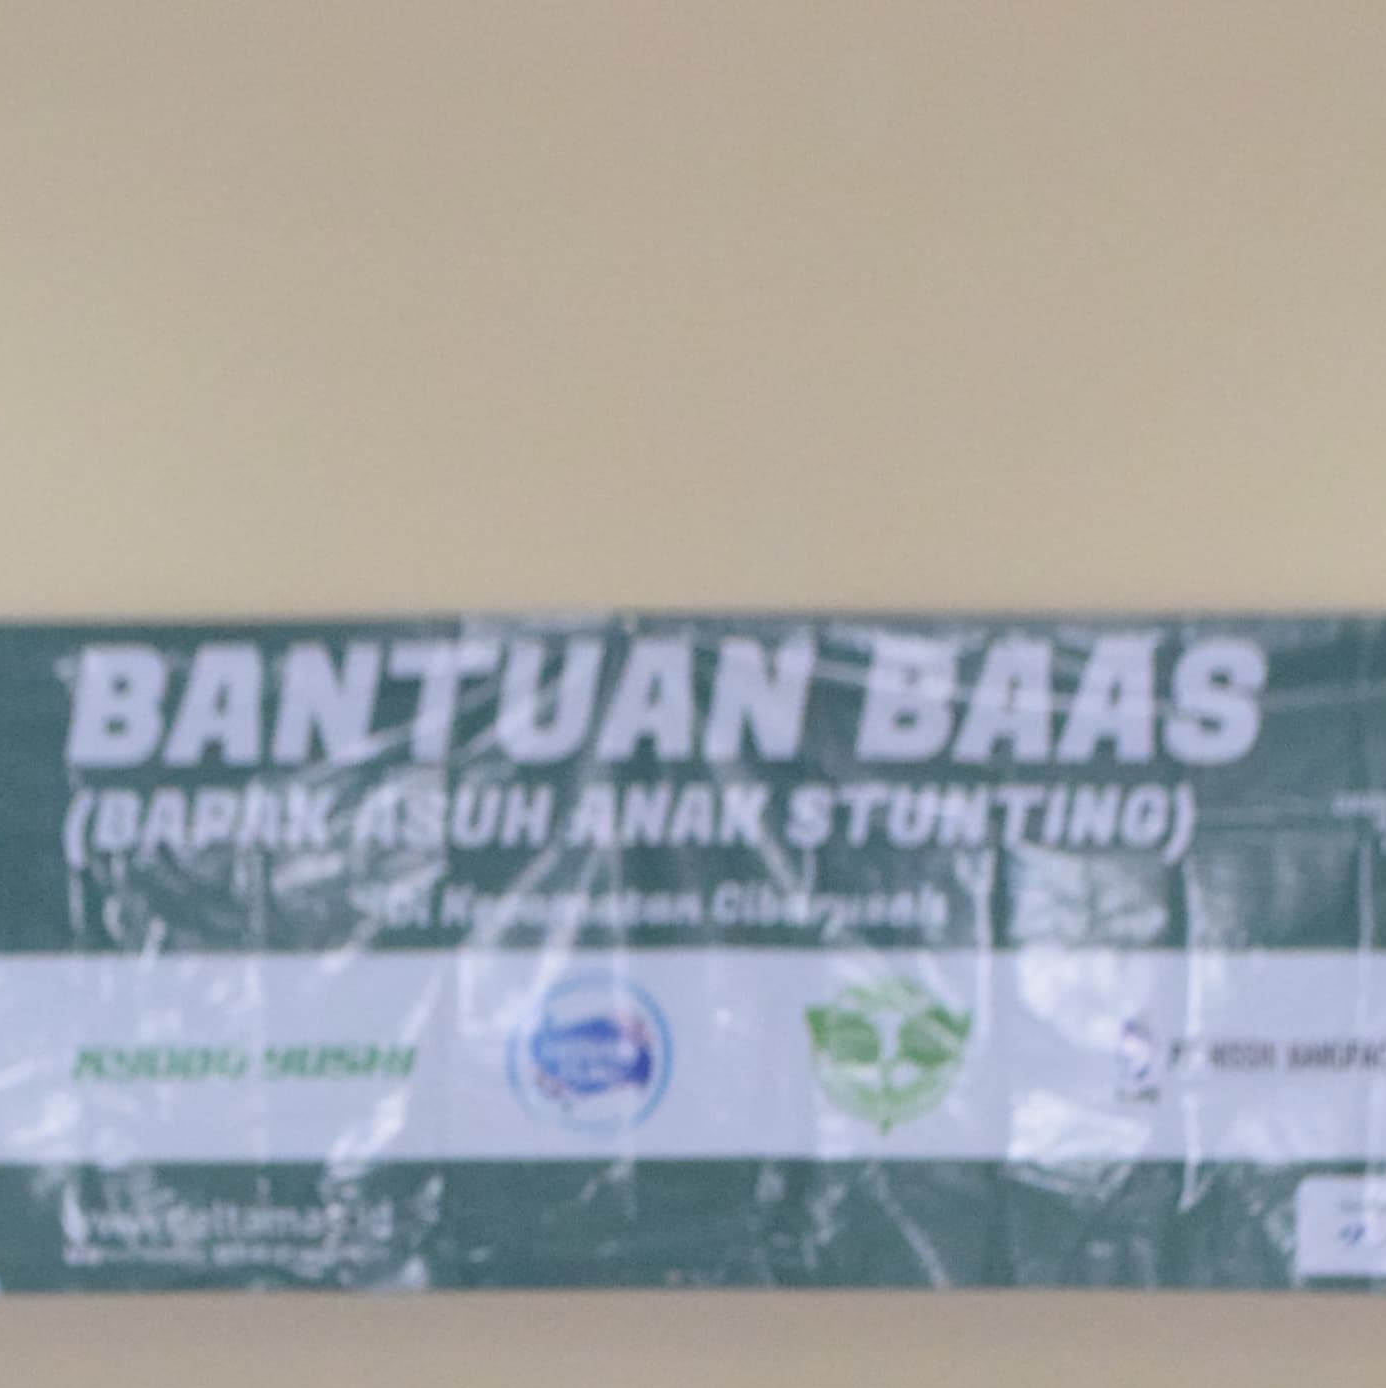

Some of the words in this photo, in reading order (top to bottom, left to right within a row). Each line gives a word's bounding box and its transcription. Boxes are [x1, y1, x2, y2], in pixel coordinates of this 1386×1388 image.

[65, 638, 813, 767] BANTUAN
[856, 633, 1268, 765] BAAS
[62, 784, 331, 871] (BAPAK
[351, 781, 551, 850] ASUH
[569, 780, 767, 849] ANAK
[785, 779, 1196, 865] STUNTING)
